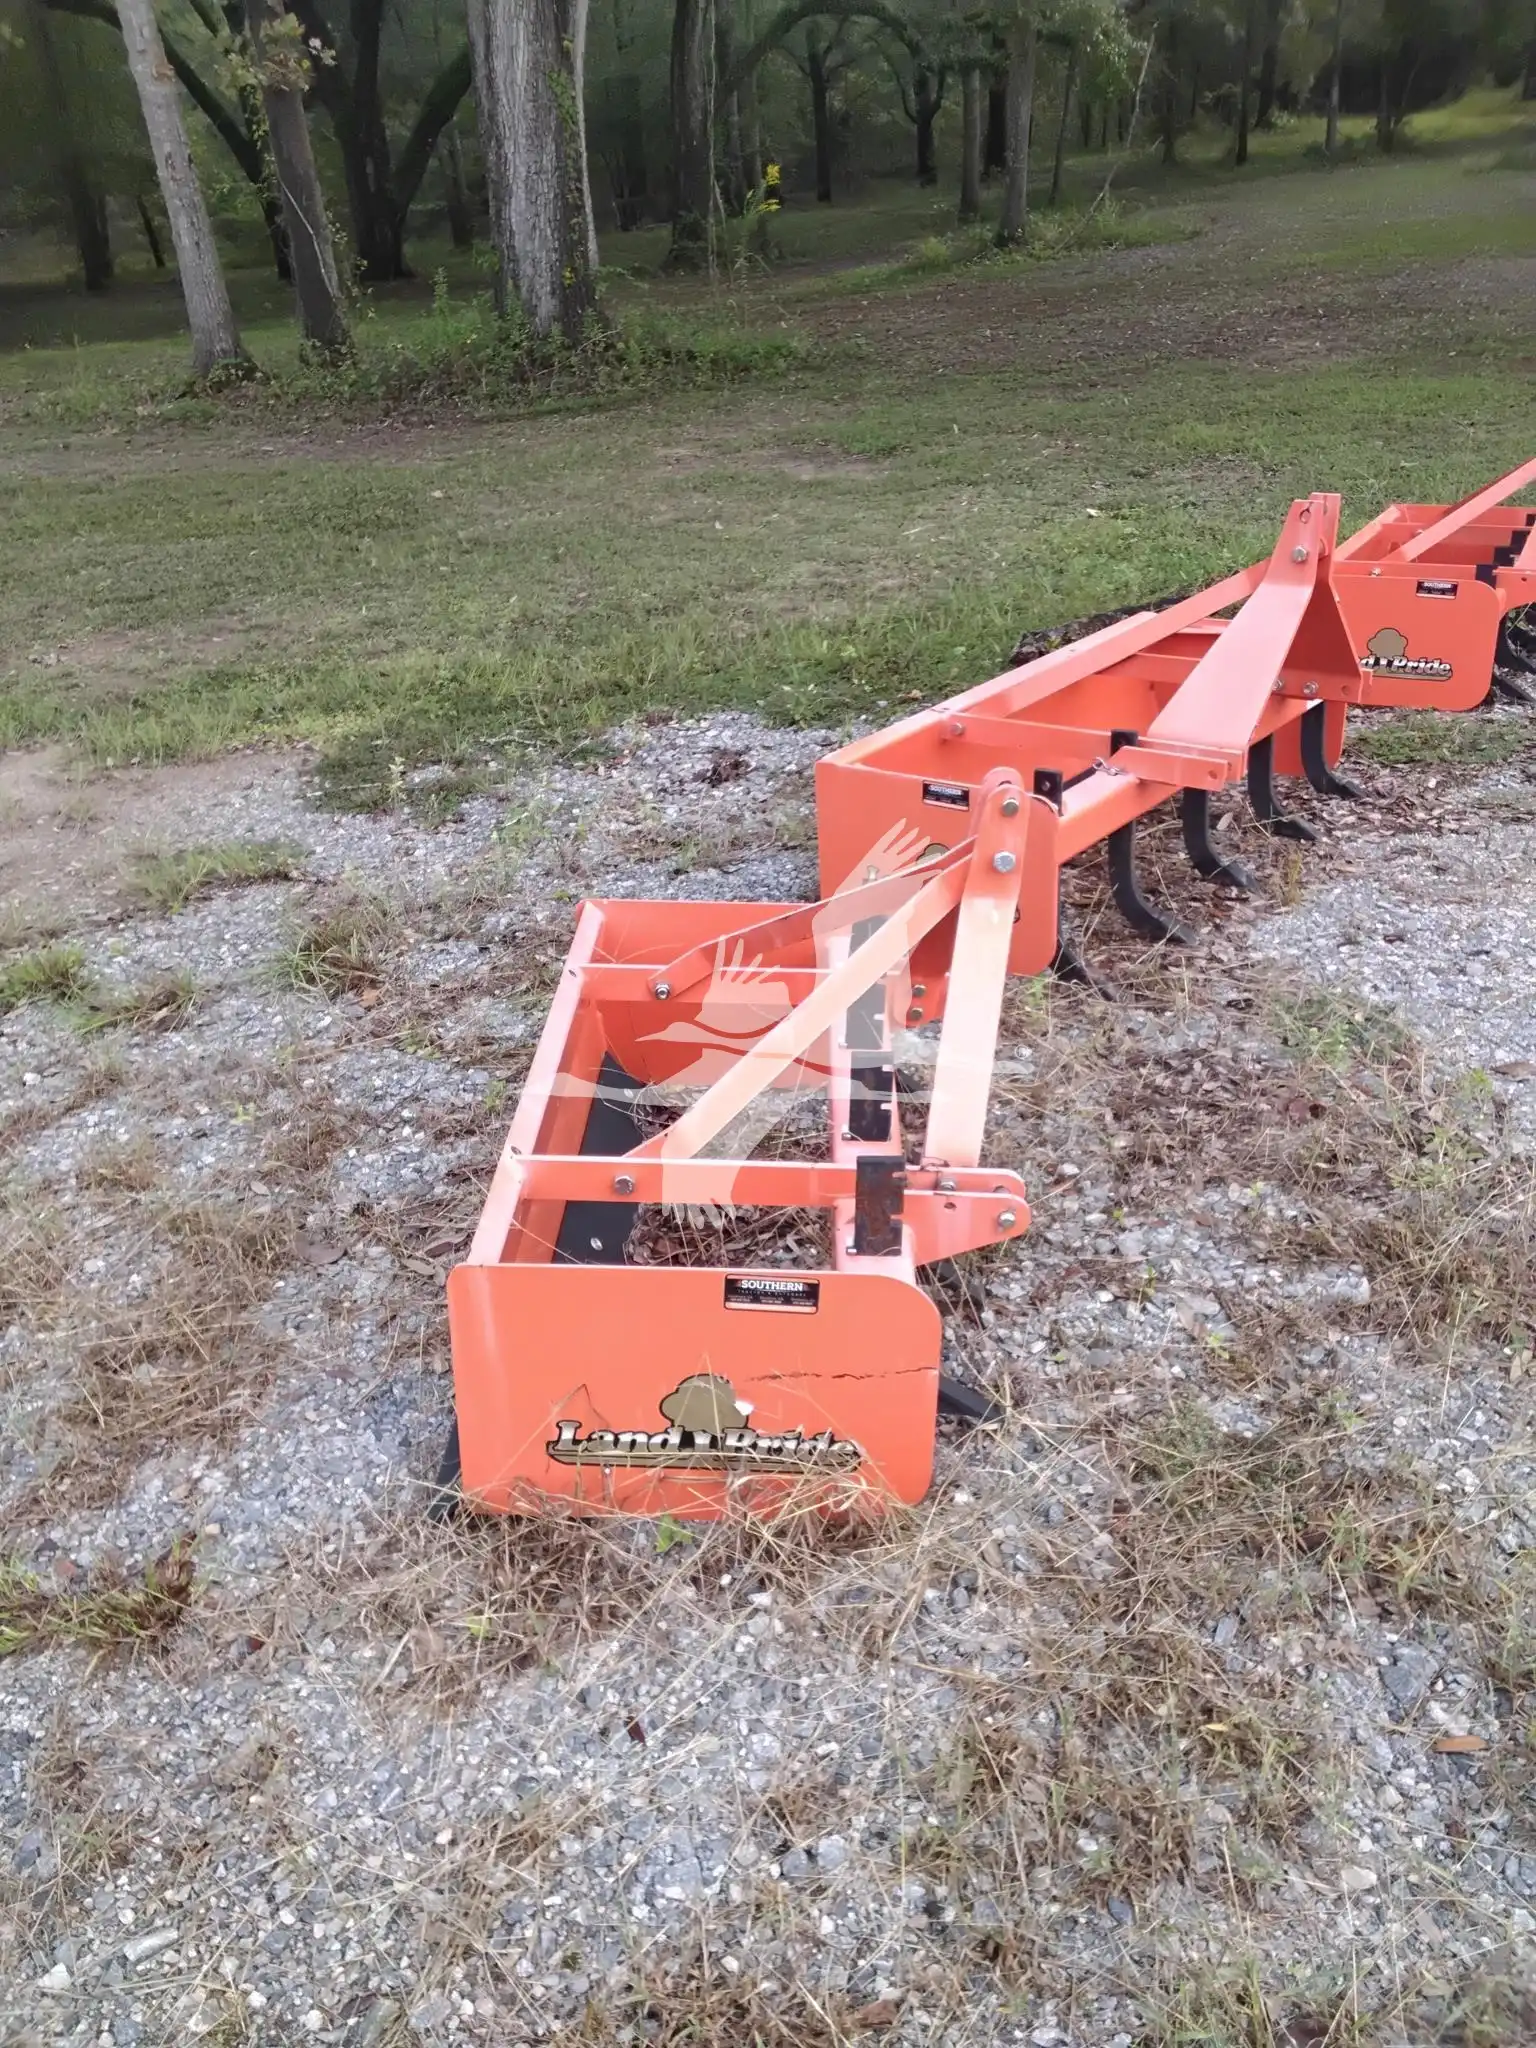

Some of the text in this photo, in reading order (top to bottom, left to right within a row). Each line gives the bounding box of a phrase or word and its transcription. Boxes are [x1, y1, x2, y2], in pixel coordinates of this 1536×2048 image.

[1392, 656, 1451, 674] Pride
[741, 1280, 803, 1291] SOUTHERN
[554, 1421, 857, 1462] Land Pride
